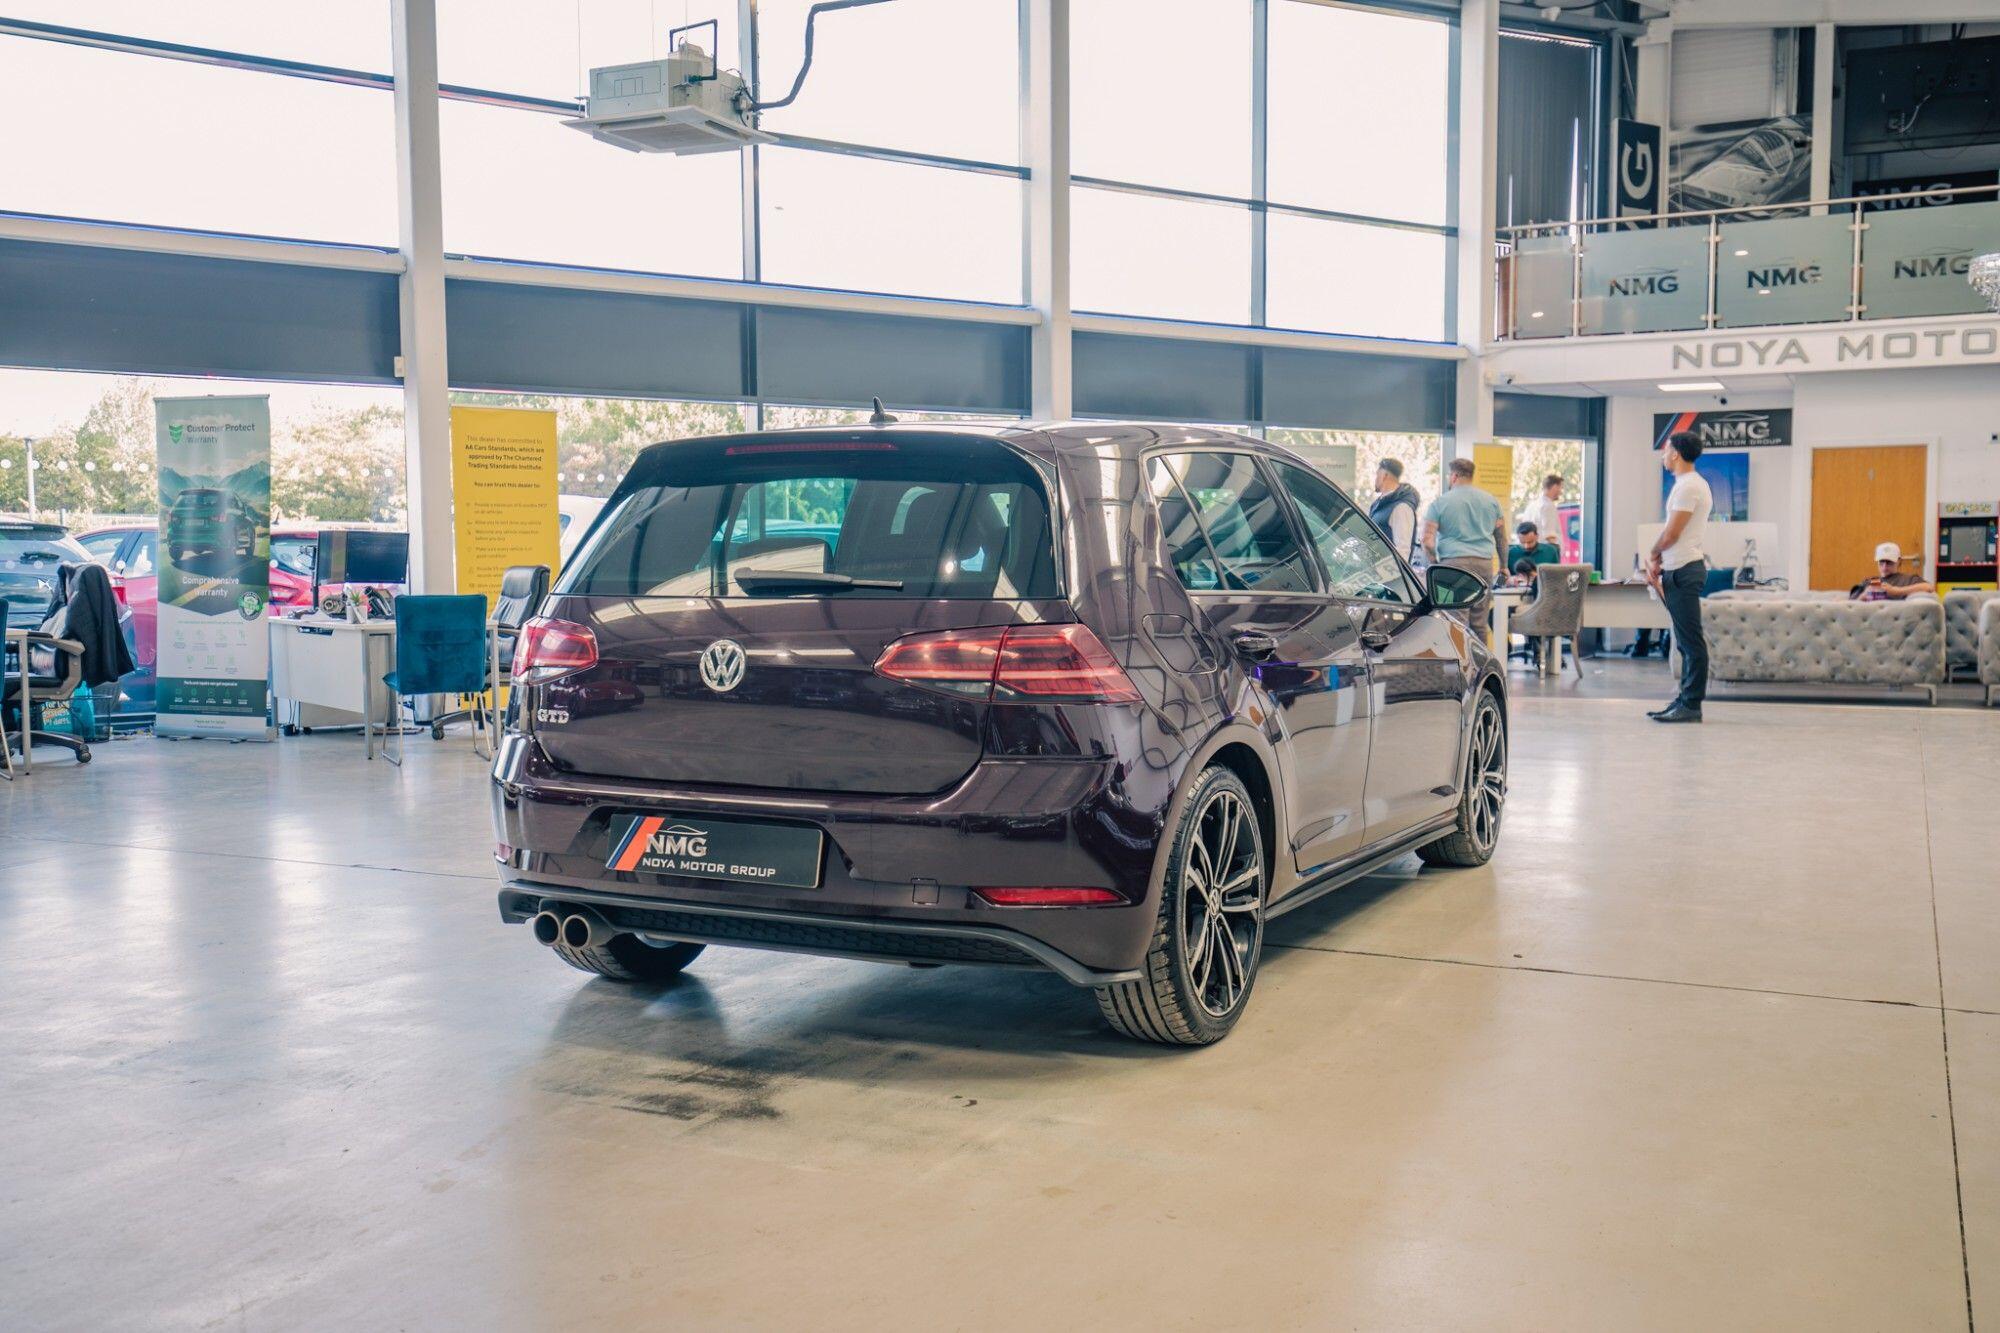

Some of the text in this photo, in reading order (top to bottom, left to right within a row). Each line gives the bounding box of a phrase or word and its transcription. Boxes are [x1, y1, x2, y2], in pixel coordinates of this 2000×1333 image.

[1747, 266, 1820, 288] NMG
[1894, 256, 1972, 278] NMG
[1610, 275, 1679, 297] NMG
[1673, 328, 1998, 369] NOYA MOTO
[187, 423, 256, 433] Customer Protect
[1700, 421, 1769, 440] NMG
[1750, 438, 1782, 446] GROUP
[183, 576, 239, 586] Comprehensive
[537, 708, 570, 724] GTD
[645, 834, 707, 857] NMG
[642, 857, 776, 878] NOYA MOTOR GROUP
